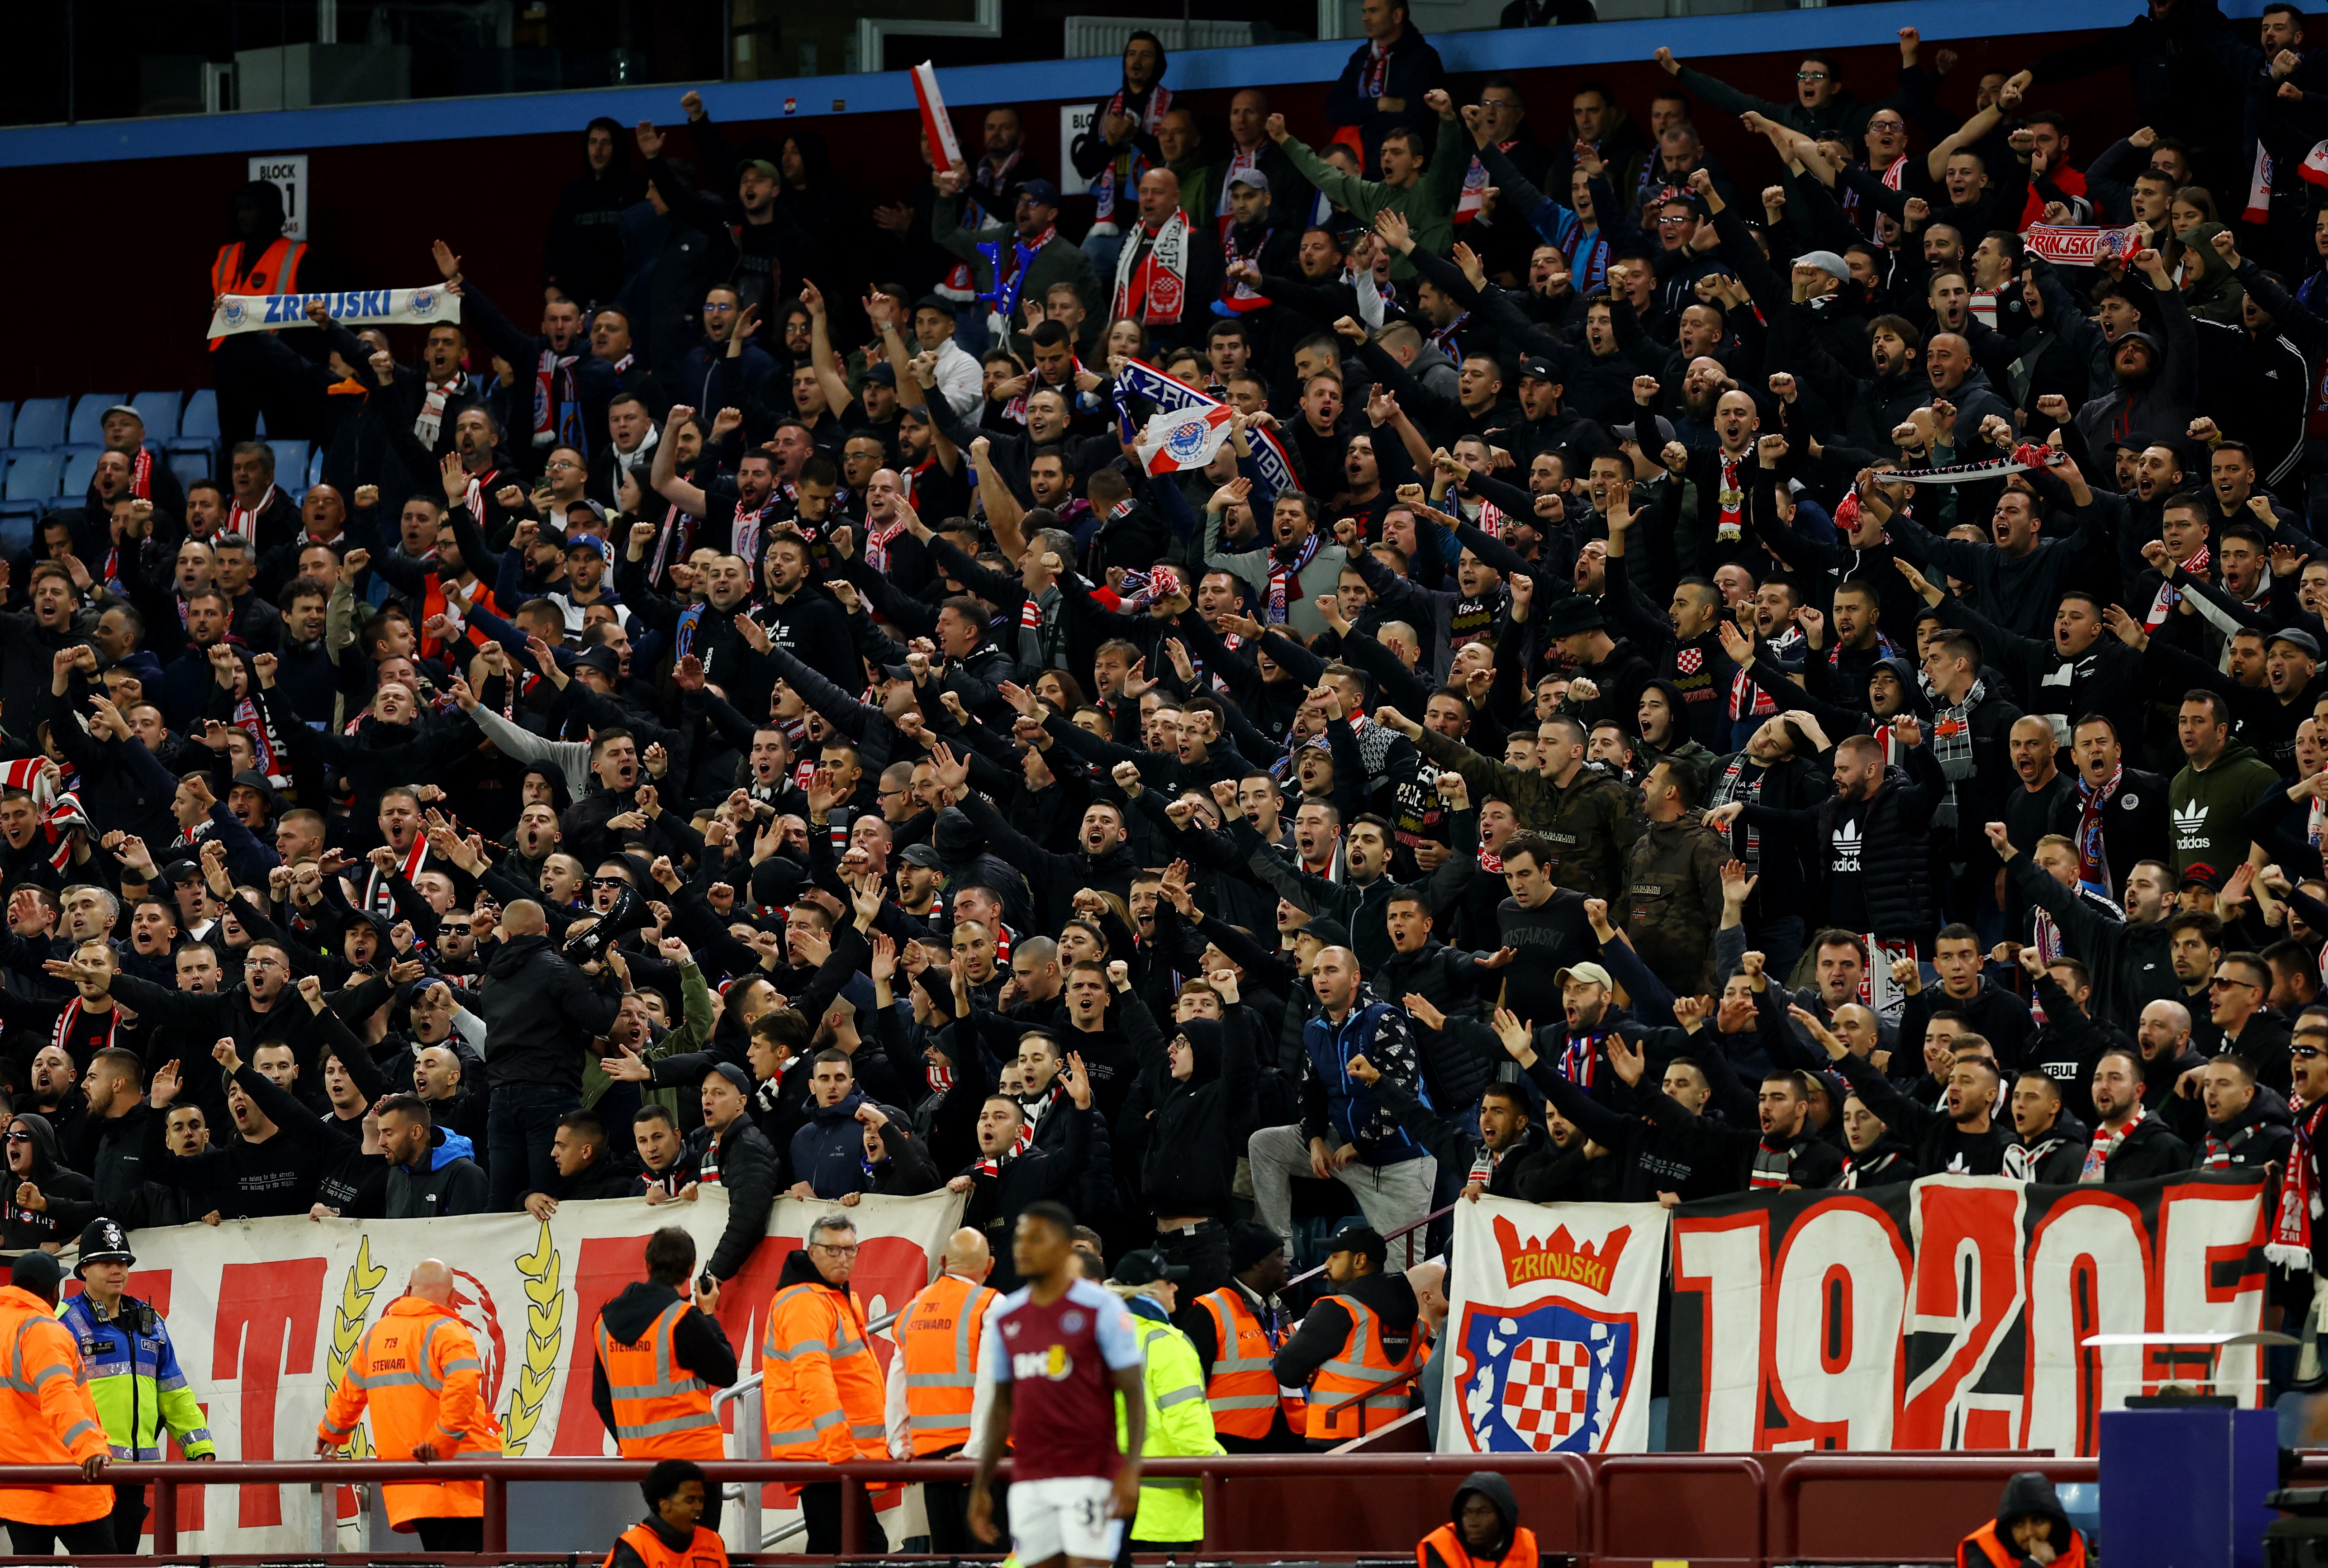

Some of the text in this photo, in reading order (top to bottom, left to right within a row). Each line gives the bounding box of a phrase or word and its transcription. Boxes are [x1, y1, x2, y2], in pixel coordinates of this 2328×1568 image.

[260, 165, 295, 180] BLOCK
[1172, 450, 1203, 462] MOSTAR
[703, 646, 714, 674] adidas
[579, 782, 593, 796] SA
[2176, 836, 2210, 850] adidas
[1832, 857, 1861, 872] adid
[1098, 1072, 1111, 1080] night
[2045, 1065, 2076, 1077] TBUL
[1511, 1251, 1608, 1291] ZRINJSKI
[908, 1319, 952, 1331] STEWARD
[384, 1337, 398, 1349] 779
[372, 1358, 406, 1372] STEWARD
